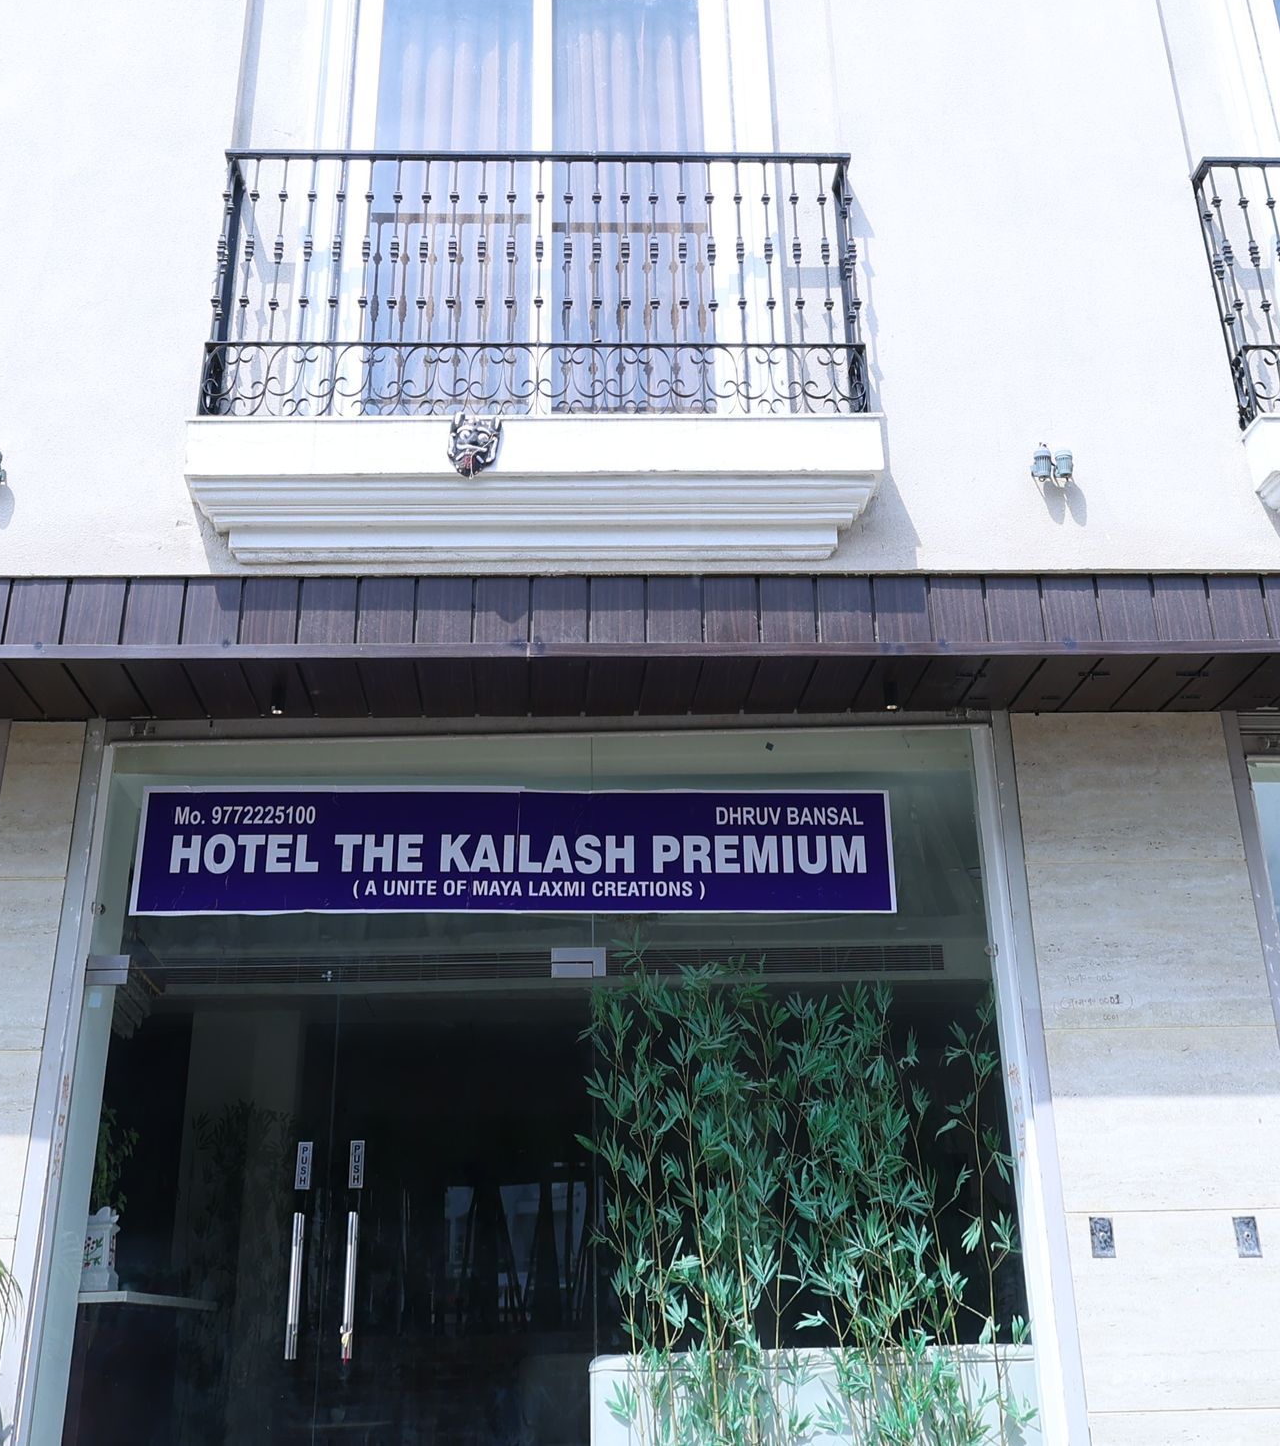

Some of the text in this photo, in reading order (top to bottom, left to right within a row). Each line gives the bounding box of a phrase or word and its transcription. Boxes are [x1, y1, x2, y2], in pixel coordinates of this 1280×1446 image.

[174, 805, 316, 825] Mo. 9772225100
[715, 807, 864, 826] DHRUV BANSAL
[169, 833, 868, 875] HOTEL THE KAILASH PREMIUM
[364, 880, 377, 896] A
[383, 880, 437, 896] UNITE
[443, 879, 467, 896] OF
[472, 880, 522, 896] MAYA
[528, 881, 586, 897] LAXMI
[592, 881, 693, 897] CREATIONS
[299, 1146, 309, 1185] PUSH
[352, 1144, 361, 1184] PUSH
